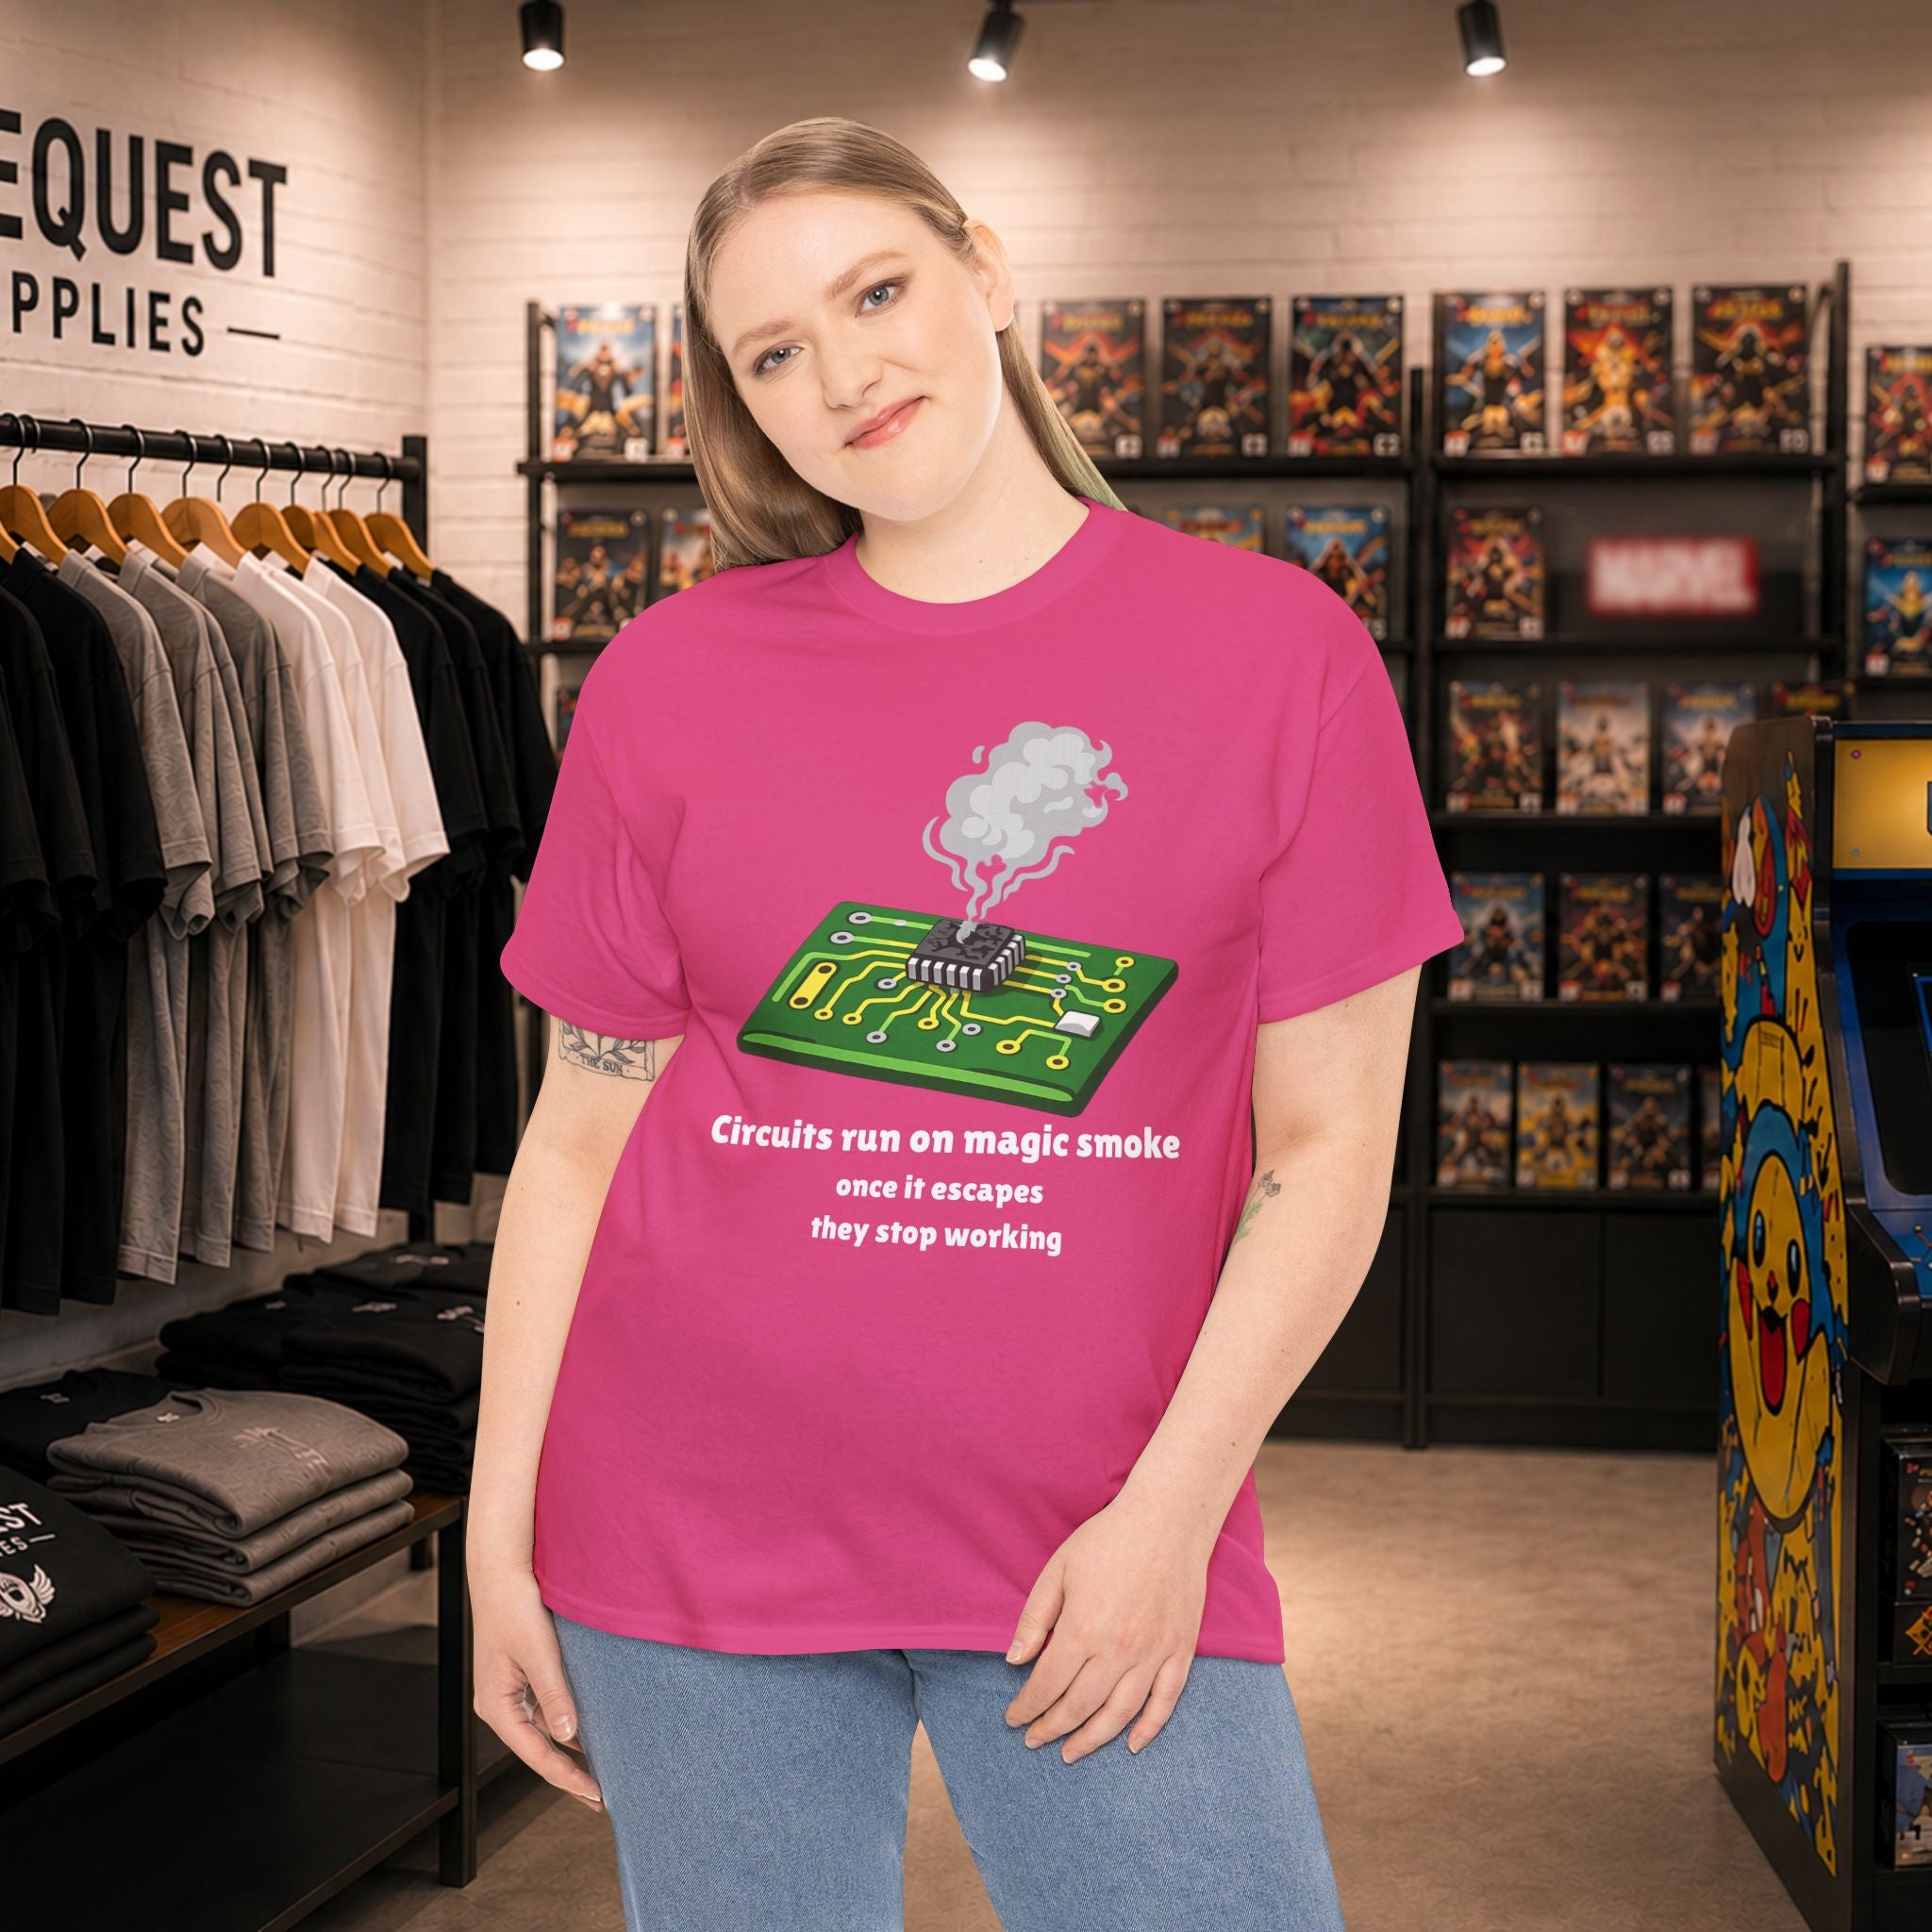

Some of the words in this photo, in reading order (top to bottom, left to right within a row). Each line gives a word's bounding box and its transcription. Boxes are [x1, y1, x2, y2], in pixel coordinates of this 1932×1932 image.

[11, 271, 204, 357] PPLIES
[580, 1055, 600, 1070] THE
[603, 1059, 624, 1075] SUN
[711, 1114, 833, 1151] Circuits
[841, 1128, 901, 1153] run
[909, 1129, 954, 1154] on
[963, 1124, 1070, 1164] magic
[1075, 1126, 1180, 1159] smoke
[836, 1178, 898, 1199] once
[904, 1174, 925, 1200] it
[930, 1181, 1043, 1208] escapes
[810, 1214, 870, 1247] they
[874, 1222, 938, 1252] stop
[944, 1223, 1062, 1257] working
